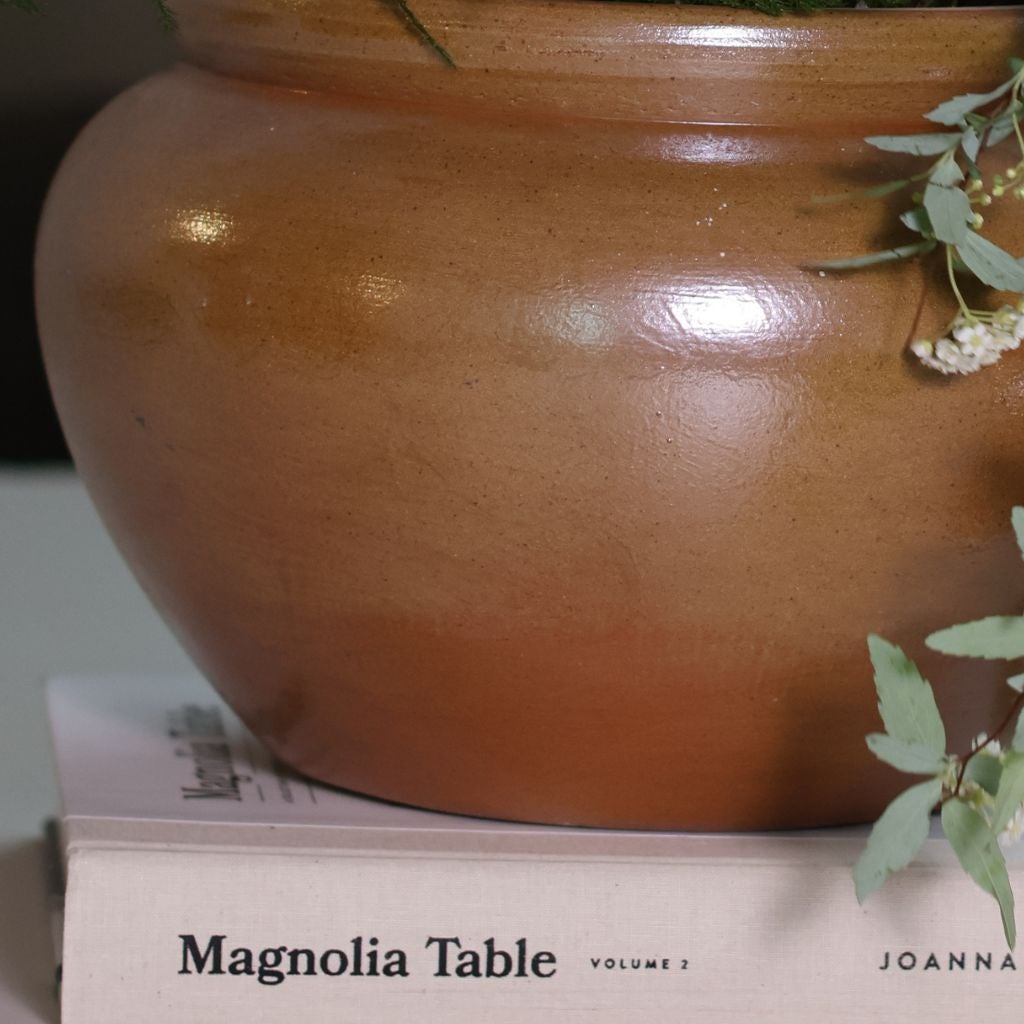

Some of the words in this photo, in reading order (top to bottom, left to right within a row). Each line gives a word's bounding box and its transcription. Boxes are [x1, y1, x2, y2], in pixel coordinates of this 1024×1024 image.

[177, 933, 410, 986] Magnolia
[425, 935, 557, 979] Table
[590, 958, 670, 970] VOLUME
[681, 959, 689, 970] 2
[878, 951, 1017, 972] JOANNA
